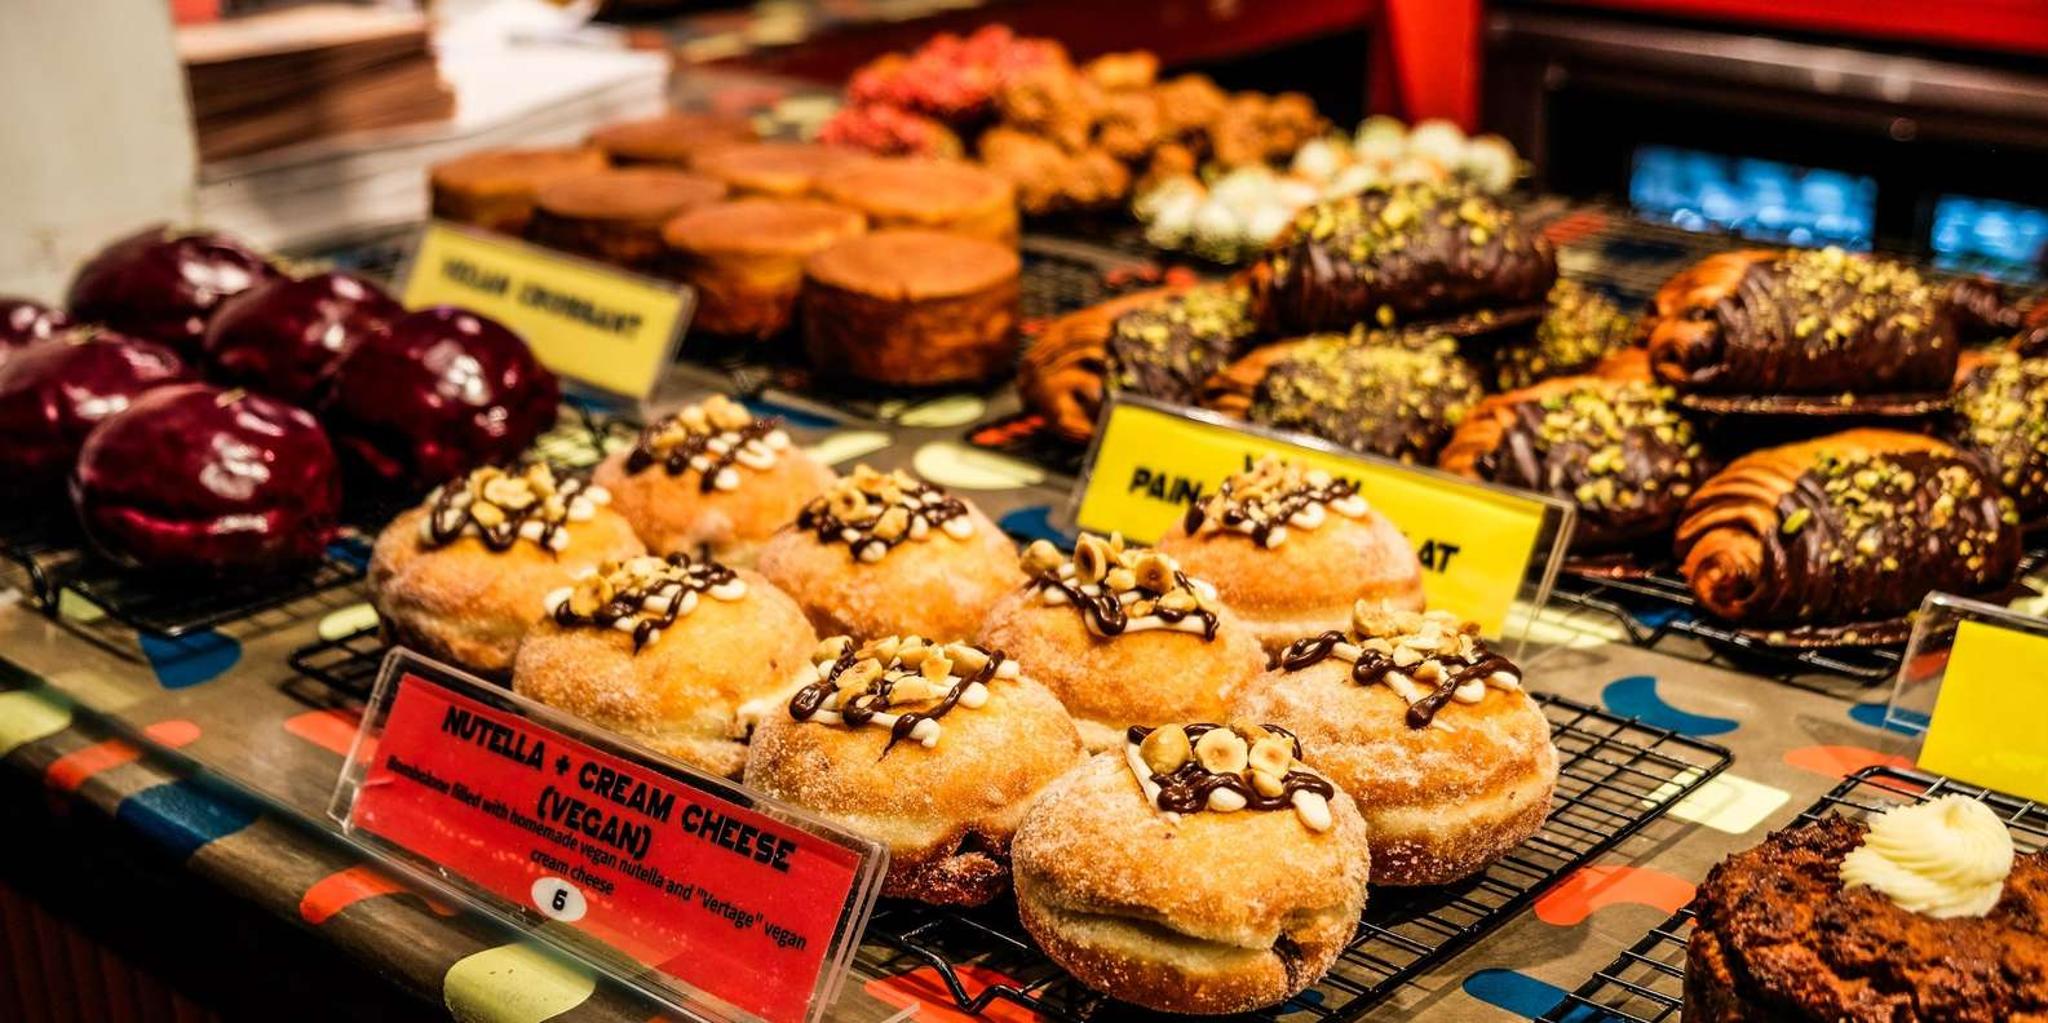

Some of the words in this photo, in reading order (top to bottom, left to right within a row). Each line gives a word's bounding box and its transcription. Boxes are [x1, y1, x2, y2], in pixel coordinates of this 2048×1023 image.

[1128, 466, 1203, 507] PAIN
[441, 705, 546, 770] NUTELLA
[554, 754, 571, 776] +
[577, 761, 676, 822] CREAM
[681, 804, 798, 873] CHEESE
[536, 785, 653, 860] (VEGAN)
[451, 782, 483, 807] filled
[482, 798, 510, 820] with
[510, 808, 578, 849] homemade
[580, 842, 617, 868] vegan
[618, 859, 664, 888] nutella
[666, 879, 694, 901] and
[698, 887, 764, 929] "Vertage"
[764, 921, 808, 950] vegan
[530, 849, 570, 876] cream
[570, 865, 615, 896] cheese
[552, 888, 568, 911] 6
